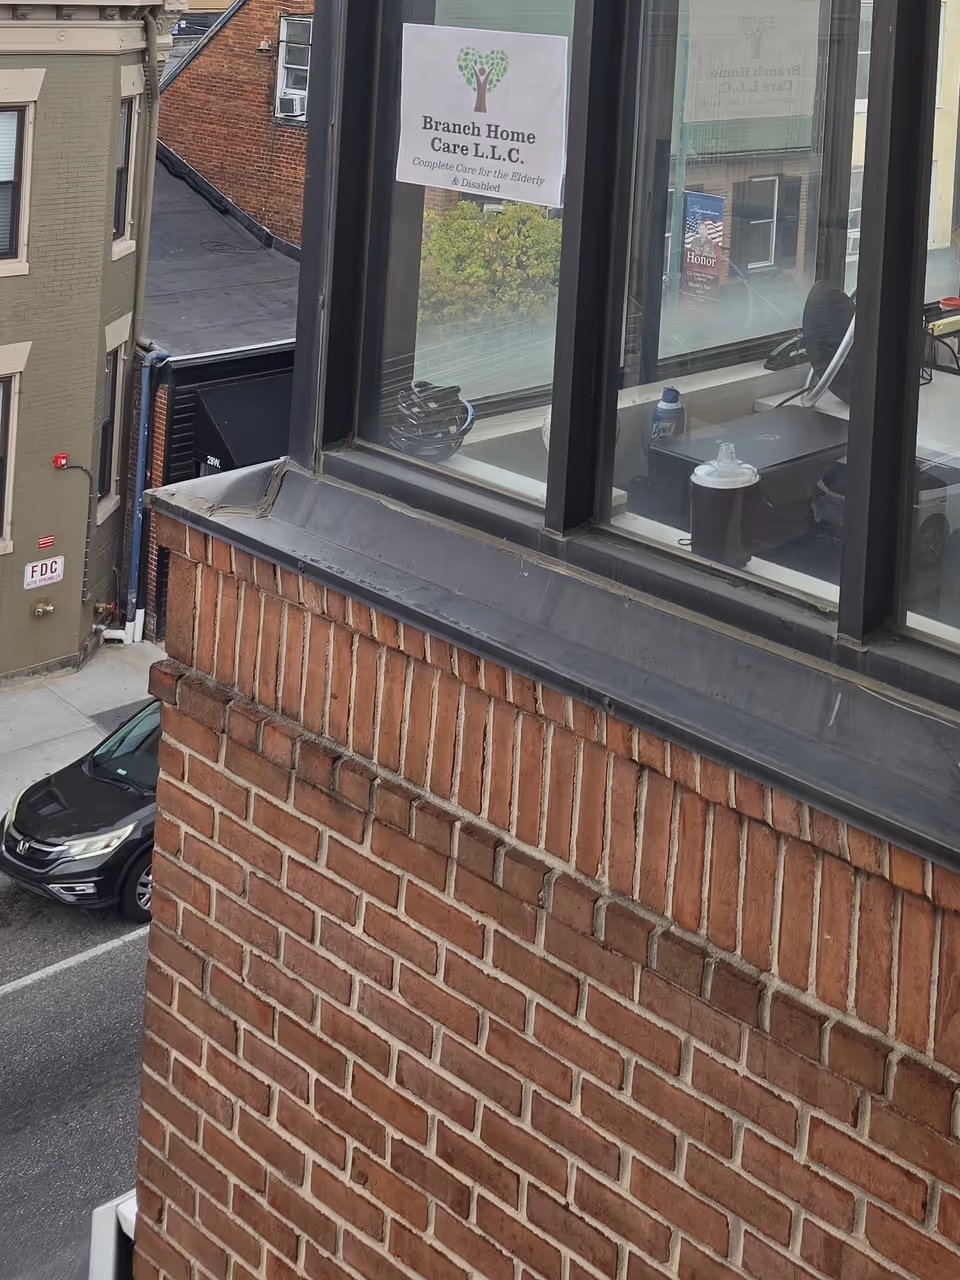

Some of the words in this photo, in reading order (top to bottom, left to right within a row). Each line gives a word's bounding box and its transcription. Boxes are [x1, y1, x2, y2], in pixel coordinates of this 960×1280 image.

[421, 115, 482, 138] Branch
[485, 123, 536, 145] Home
[430, 136, 469, 156] Care
[472, 142, 525, 165] L.L.C.
[412, 156, 455, 171] Complete
[455, 163, 477, 175] Care
[478, 166, 492, 178] for
[493, 167, 509, 180] the
[510, 171, 546, 188] Elderly
[451, 176, 460, 187] &
[460, 177, 501, 193] Disabled
[686, 250, 717, 267] Honor
[31, 560, 58, 579] FDC
